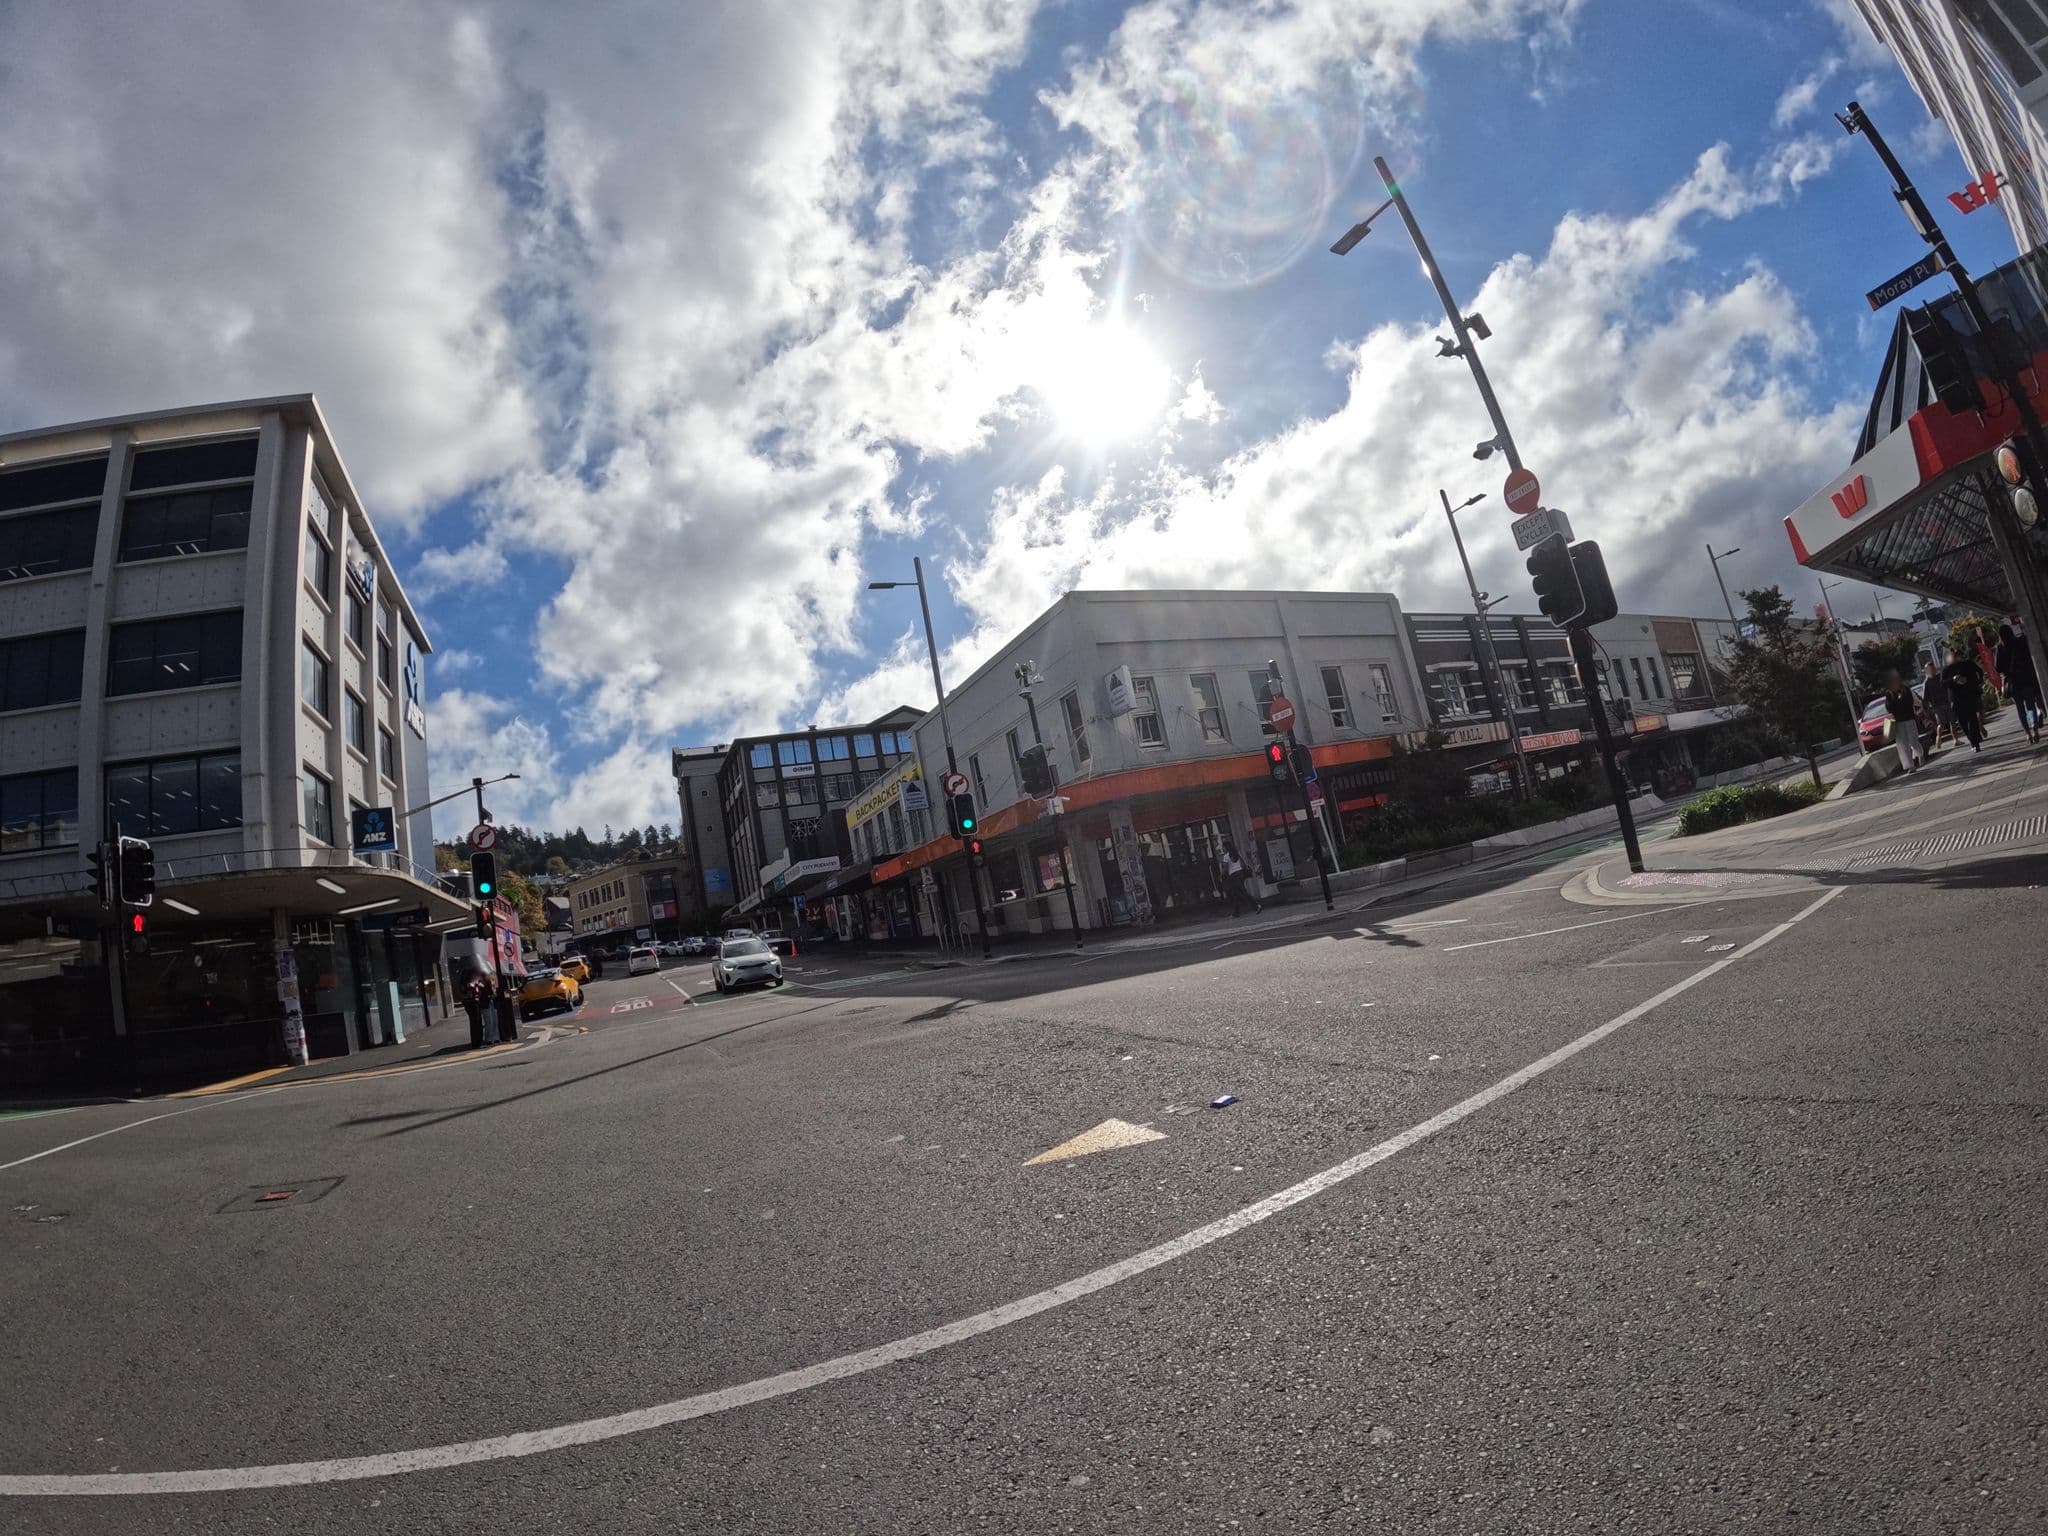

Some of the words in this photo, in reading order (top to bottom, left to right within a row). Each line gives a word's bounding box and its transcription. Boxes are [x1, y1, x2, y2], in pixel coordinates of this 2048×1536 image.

[1875, 275, 1914, 305] Moray
[1915, 264, 1931, 279] Pl
[1517, 513, 1543, 533] EXCEPT
[1520, 524, 1550, 544] CYCLES
[406, 698, 425, 739] ANZ
[1460, 728, 1484, 743] MALL
[363, 831, 387, 843] ANZ
